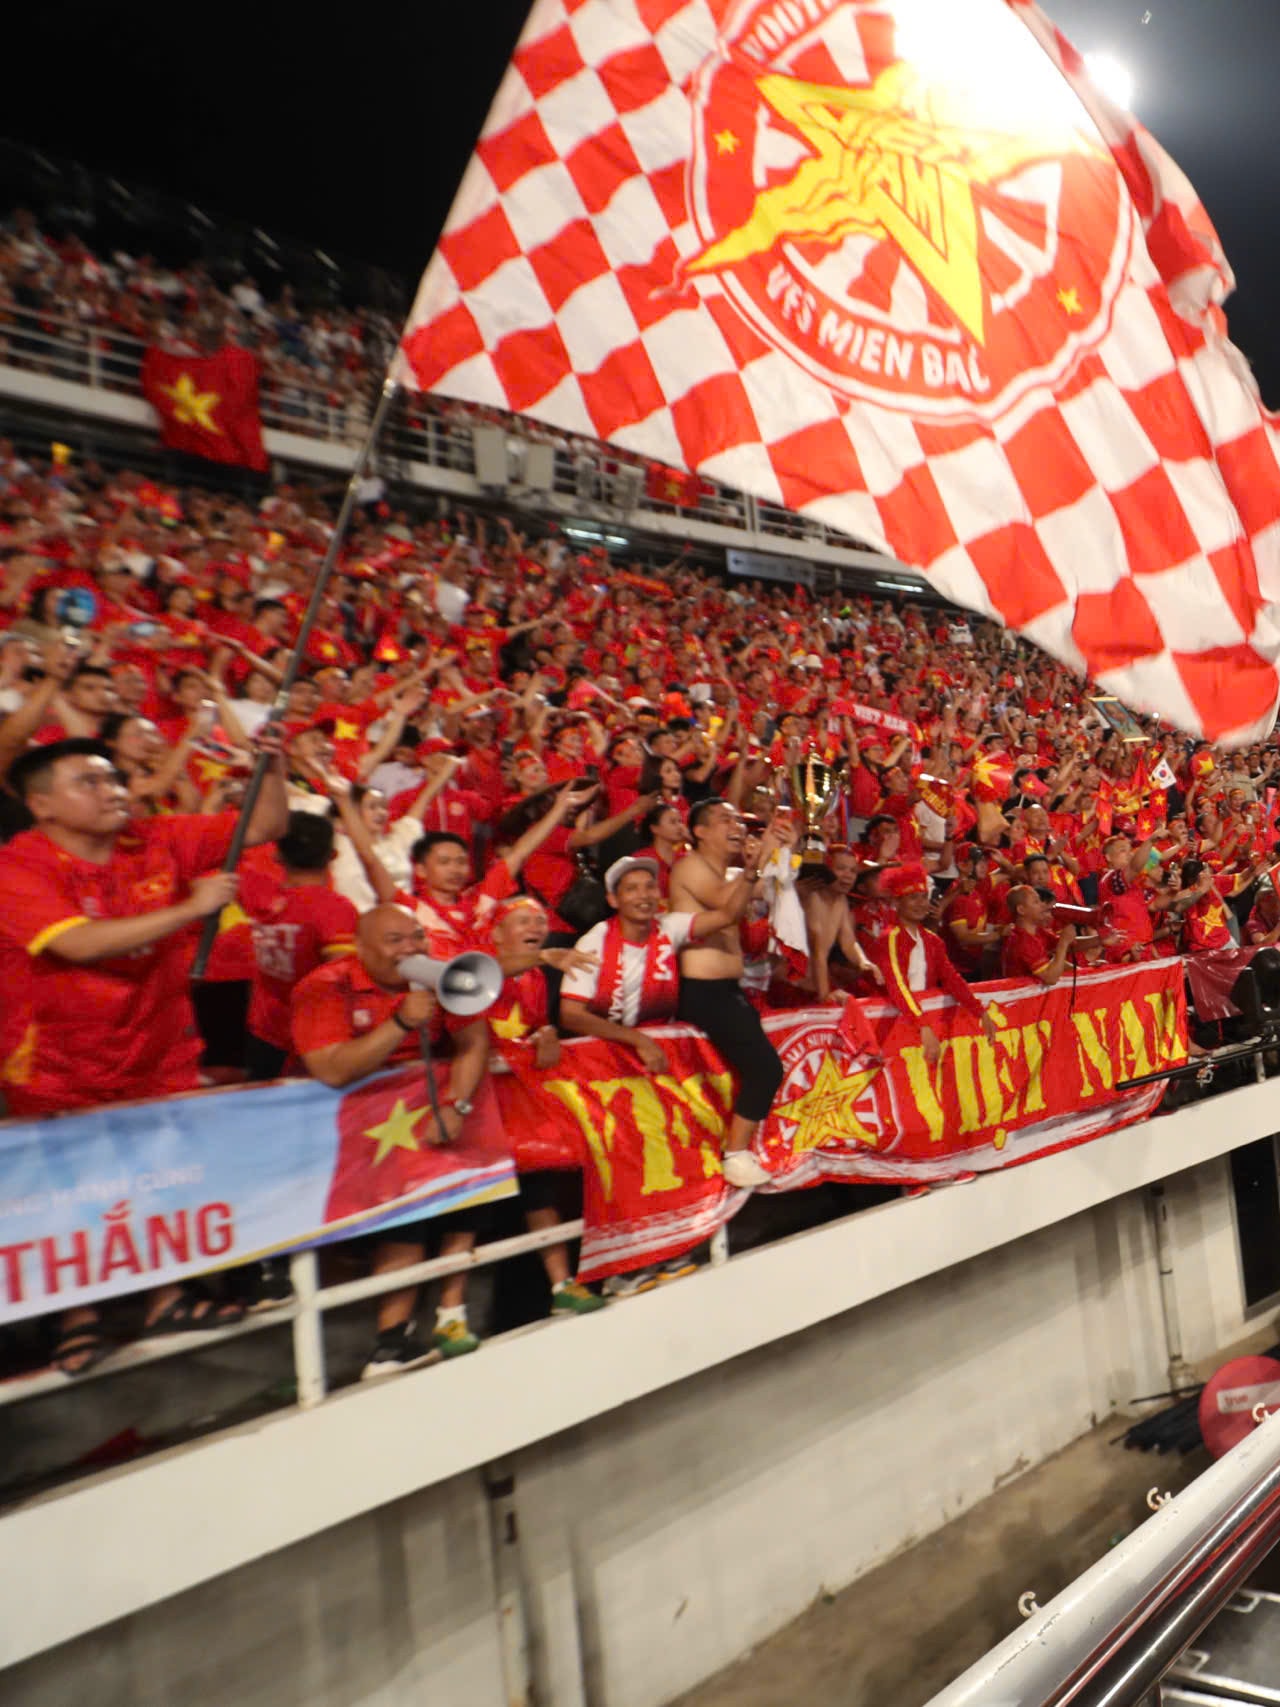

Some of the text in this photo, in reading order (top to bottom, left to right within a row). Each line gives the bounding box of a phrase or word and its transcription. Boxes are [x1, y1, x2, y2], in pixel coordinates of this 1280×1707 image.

[817, 309, 914, 381] MIEN
[1071, 989, 1188, 1098] NAM
[0, 1199, 235, 1304] THẮNG
